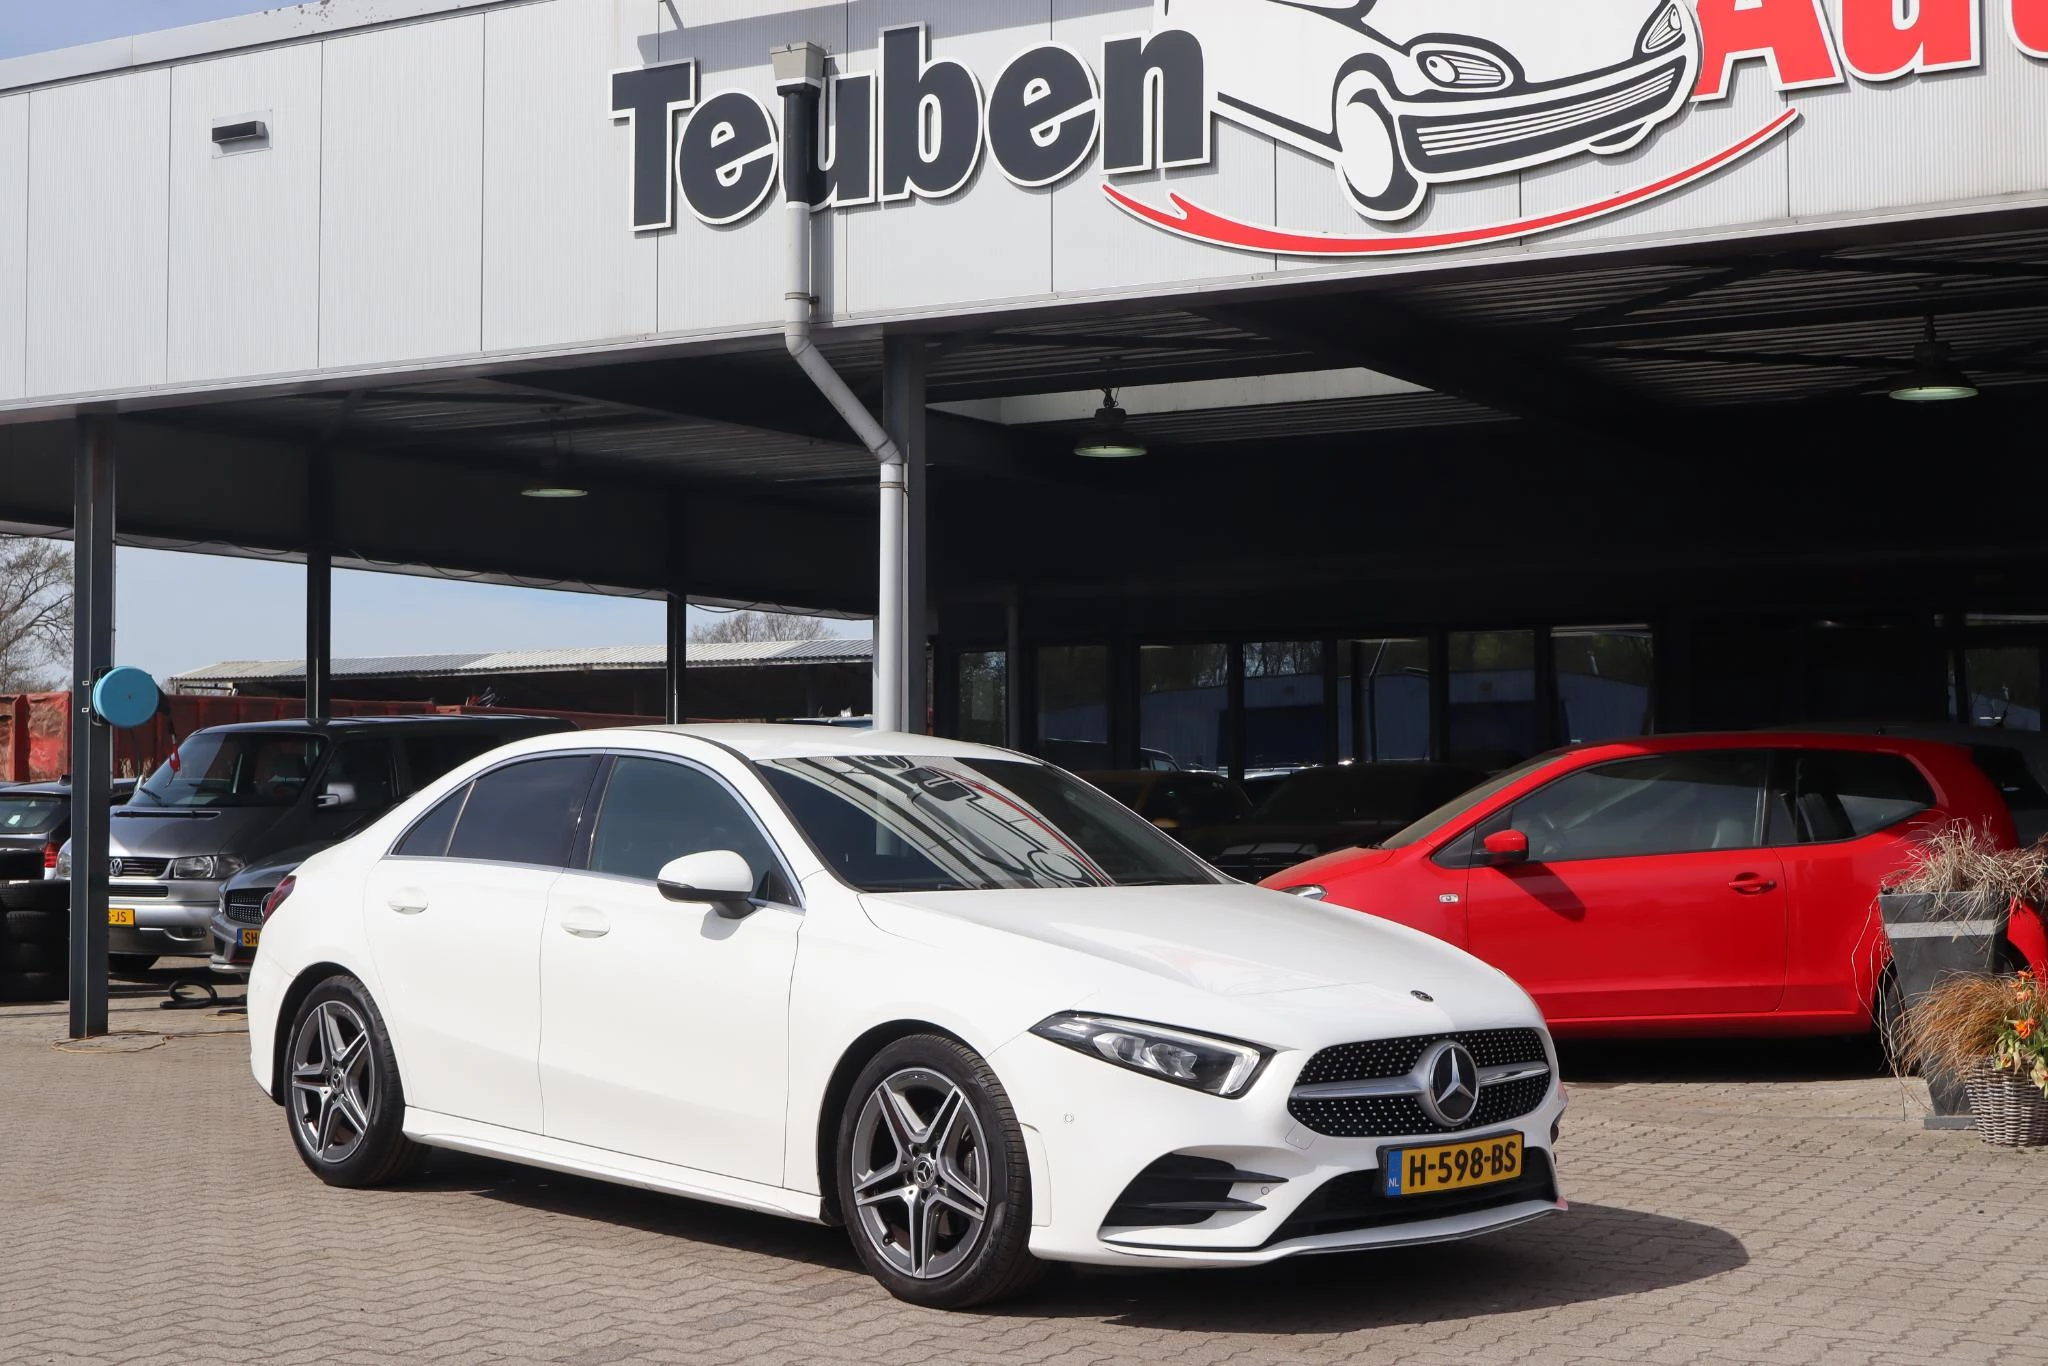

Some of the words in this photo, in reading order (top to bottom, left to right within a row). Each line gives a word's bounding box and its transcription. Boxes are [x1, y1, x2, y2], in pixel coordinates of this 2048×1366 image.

[608, 22, 1211, 231] Teuben
[1689, 0, 2048, 102] Au
[1388, 1177, 1400, 1188] NL
[1409, 1141, 1517, 1188] H-598-BS
